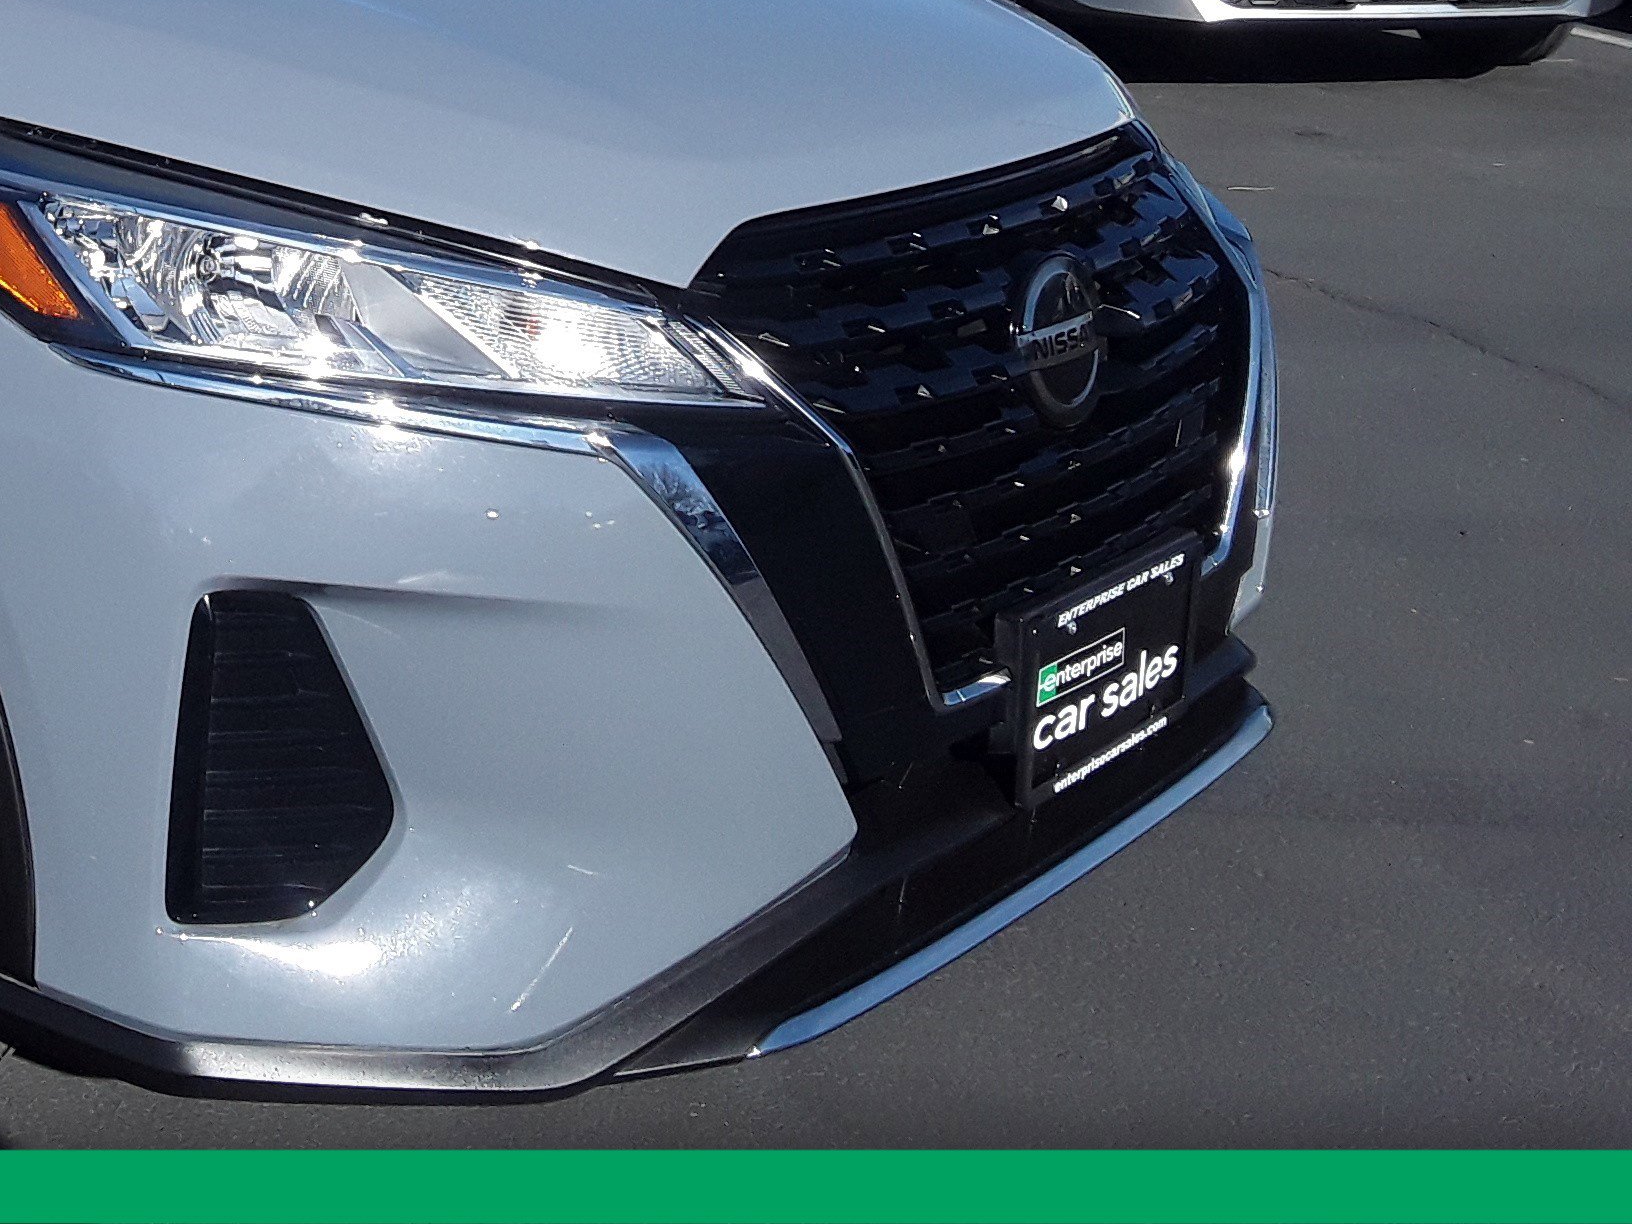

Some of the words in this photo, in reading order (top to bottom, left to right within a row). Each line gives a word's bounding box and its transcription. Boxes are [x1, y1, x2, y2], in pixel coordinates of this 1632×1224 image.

[1032, 321, 1098, 362] NISSA
[1057, 581, 1125, 628] ENTERPRISE
[1126, 570, 1148, 591] CAR
[1149, 553, 1185, 579] SALES
[1033, 694, 1095, 750] car
[1100, 645, 1179, 718] sales
[1042, 641, 1123, 692] enterprise
